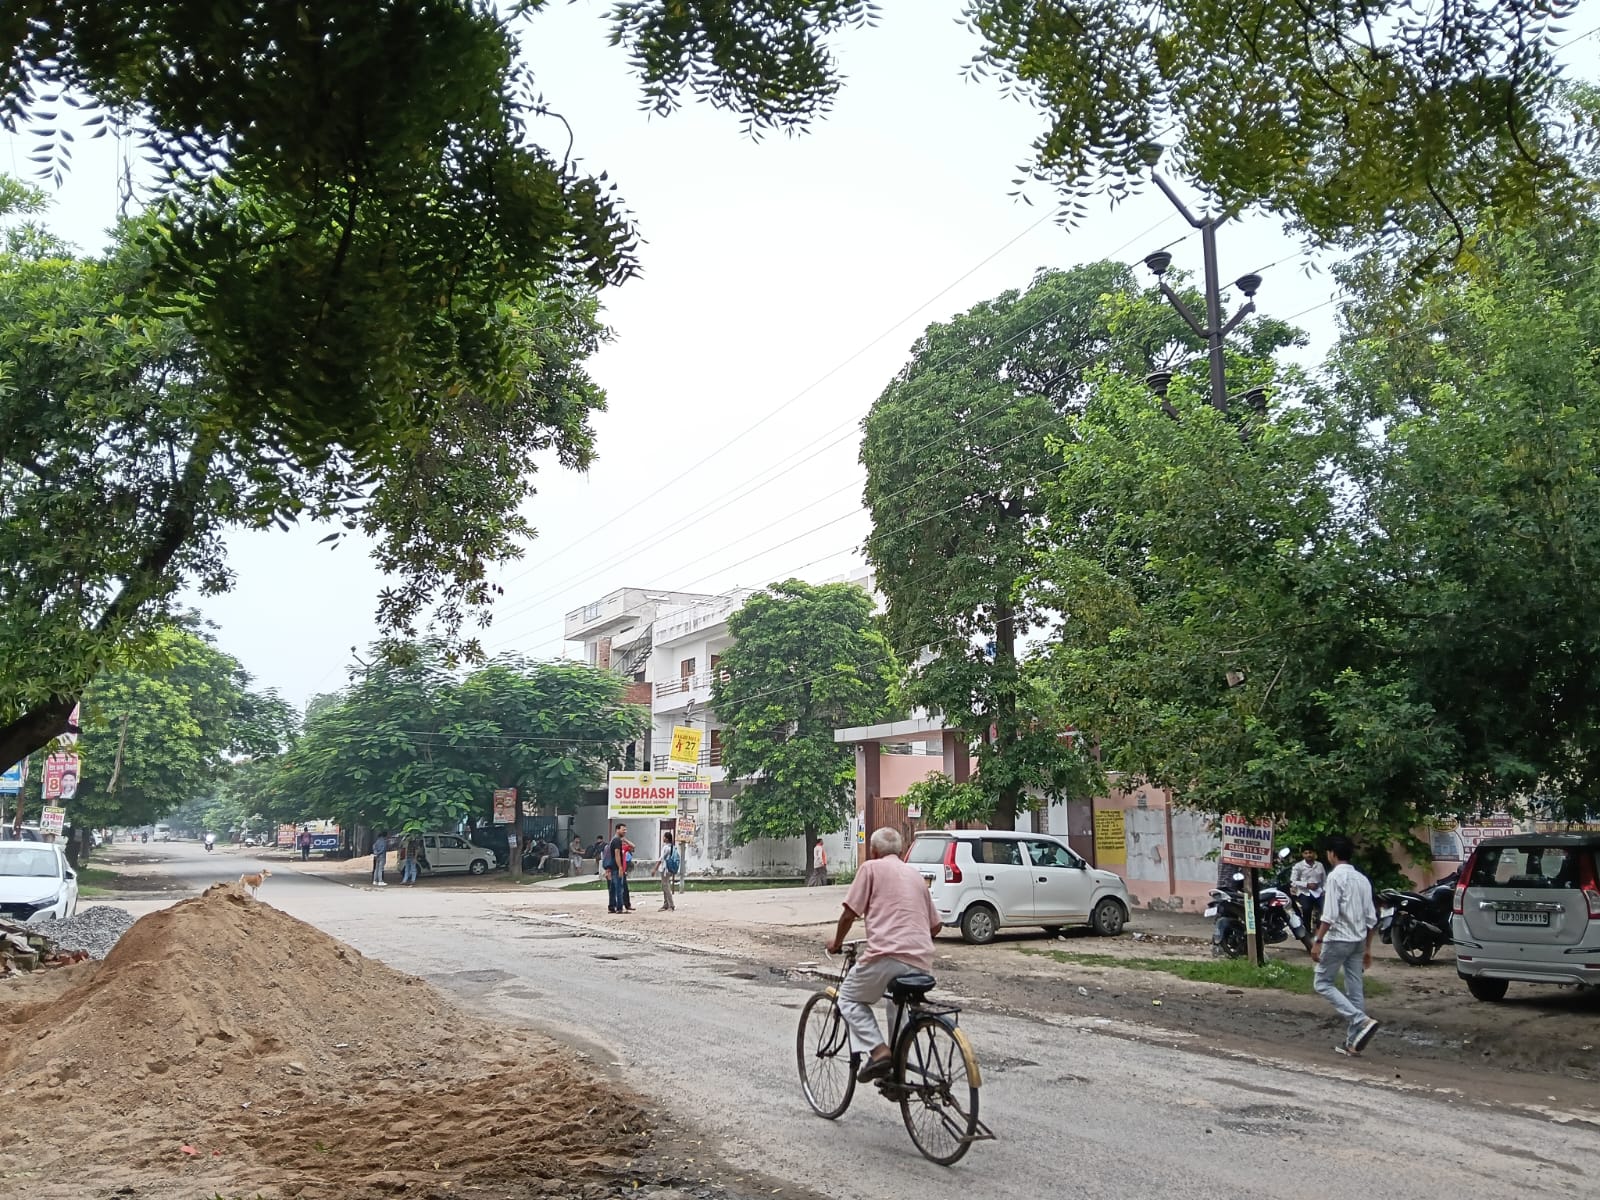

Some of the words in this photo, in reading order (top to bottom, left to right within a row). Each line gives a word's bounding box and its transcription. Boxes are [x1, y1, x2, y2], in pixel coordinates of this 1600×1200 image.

[685, 741, 697, 751] 27
[49, 778, 59, 790] 8
[615, 787, 675, 799] SUBHASH
[1224, 825, 1271, 841] RAHMAN
[1228, 844, 1245, 852] CLASS
